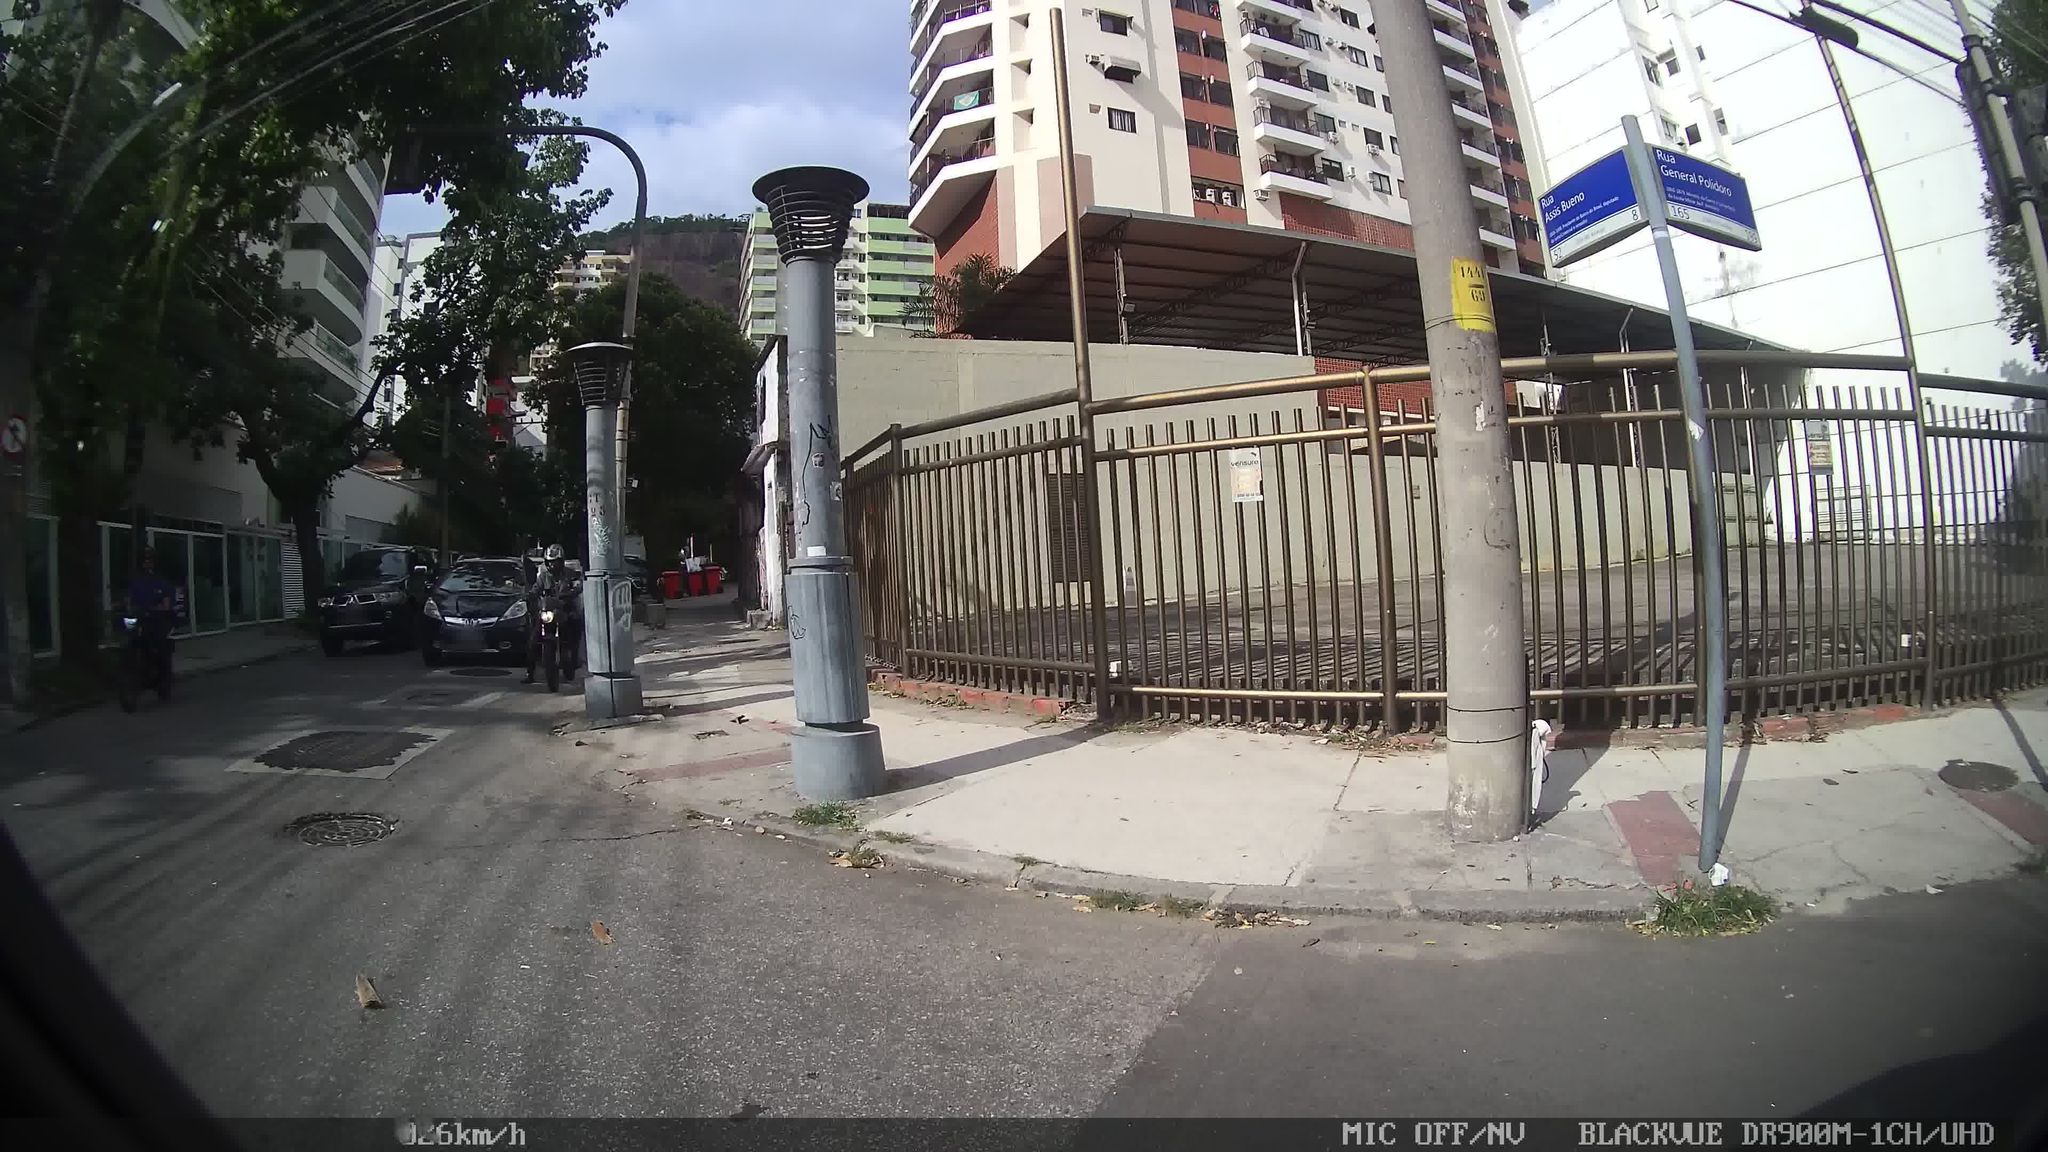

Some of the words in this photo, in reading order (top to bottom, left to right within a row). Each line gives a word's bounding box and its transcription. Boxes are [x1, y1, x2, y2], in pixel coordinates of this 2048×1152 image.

[1656, 149, 1676, 164] Rua
[1660, 164, 1698, 184] General
[1698, 175, 1733, 197] Polidoro
[1541, 195, 1554, 210] Rua
[1545, 206, 1561, 223] Assis
[1560, 192, 1585, 212] Bueno
[1631, 209, 1639, 221] 8
[1671, 205, 1690, 219] 165
